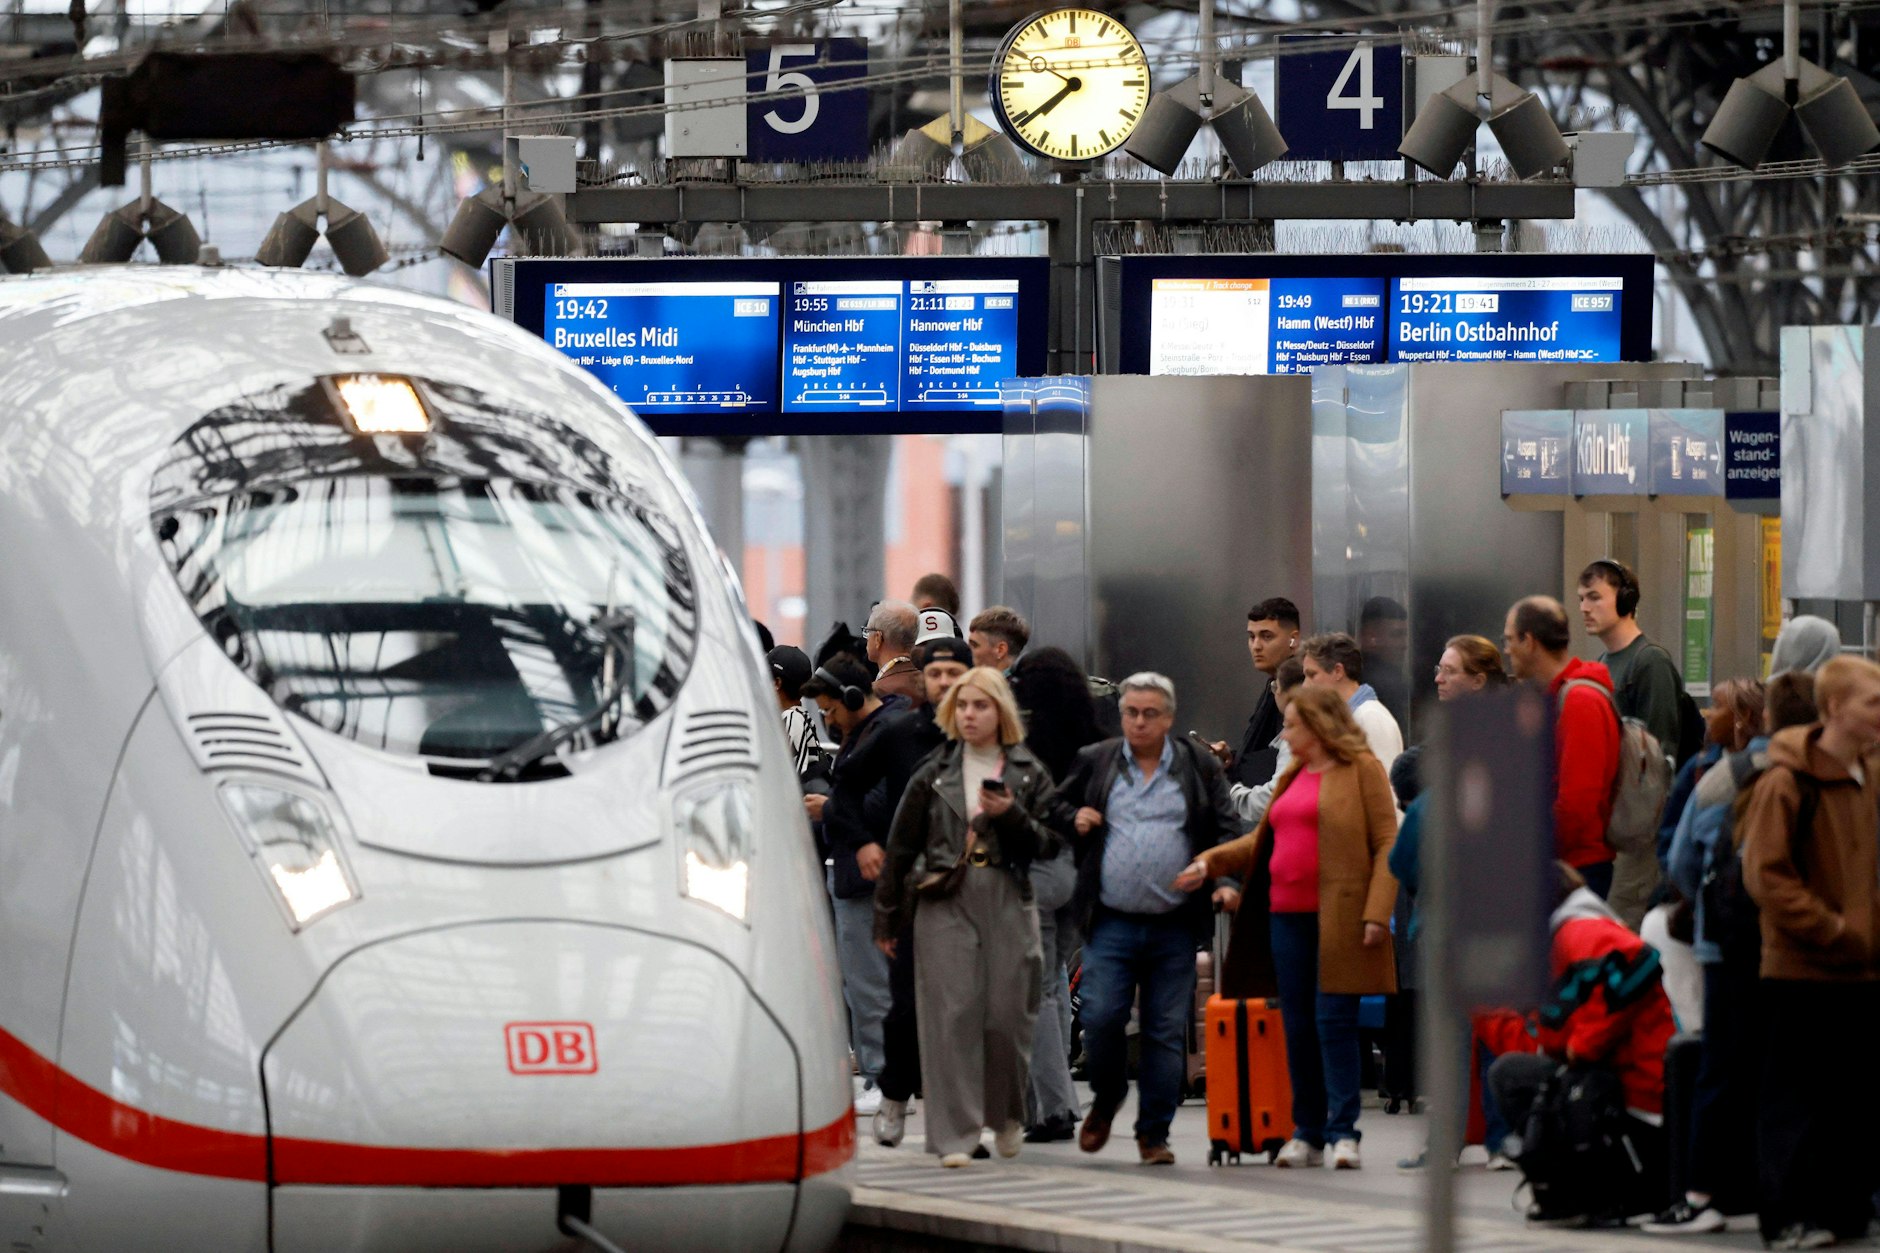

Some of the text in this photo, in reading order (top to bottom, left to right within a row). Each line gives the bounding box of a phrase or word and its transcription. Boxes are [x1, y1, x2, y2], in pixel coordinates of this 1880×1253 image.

[762, 42, 821, 135] 5
[1326, 41, 1384, 131] 4
[1229, 282, 1253, 290] change
[1541, 280, 1550, 288] 27
[736, 302, 767, 312] ICE 10
[794, 299, 828, 311] 19:55
[911, 297, 944, 310] 21:11
[1278, 295, 1312, 309] 19:49
[1401, 294, 1494, 313] 19:21 19:41
[1574, 297, 1610, 308] ICE 957
[555, 299, 608, 319] 19:42
[794, 319, 864, 332] München Hbf
[910, 318, 983, 332] Hannover Hbf
[1277, 316, 1374, 331] Hamm (Westf) Hbf
[555, 327, 678, 348] Bruxelles Midi
[1400, 321, 1558, 342] Berlin Ostbahnhof
[857, 343, 894, 352] Mannheim
[909, 343, 948, 352] Düsseldorf
[949, 343, 962, 352] Hbf
[969, 342, 1002, 353] Duisburg
[1277, 341, 1283, 350] K
[1284, 341, 1328, 351] Messe/Deutz
[1337, 340, 1374, 350] Düsseldorf
[581, 356, 594, 365] Hbf
[602, 356, 621, 367] Liège
[622, 356, 633, 366] (G)
[641, 356, 693, 365] Bruxelles-Nord
[793, 355, 806, 364] Hbf
[813, 355, 846, 365] Stuttgart
[847, 355, 860, 364] Hbf
[909, 354, 922, 363] Hbf
[930, 355, 950, 363] Essen
[952, 354, 964, 363] Hbf
[972, 354, 1000, 363] Bochum
[1160, 354, 1200, 362] Steinstraße
[1208, 353, 1223, 361] Porz
[1276, 353, 1289, 362] Hbf
[1297, 353, 1328, 363] Duisburg
[1330, 352, 1342, 361] Hbf
[1350, 353, 1370, 361] Essen
[1399, 350, 1435, 361] Wuppertal
[1436, 350, 1449, 359] Hbf
[1457, 350, 1492, 359] Dortmund
[1493, 350, 1506, 359] Hbf
[1514, 350, 1536, 359] Hamm
[1538, 350, 1564, 360] (Westf)
[1566, 350, 1578, 358] Hbf
[792, 367, 841, 377] Augsburg Hbf
[909, 366, 922, 375] Hbf
[930, 366, 965, 375] Dortmund
[966, 366, 980, 374] Hbf
[1276, 365, 1288, 373] Hbf
[1729, 430, 1780, 447] Wagen-
[1577, 422, 1631, 475] Köln Hbf
[1734, 447, 1777, 462] stand-
[925, 616, 938, 631] S
[518, 1031, 585, 1065] DB
